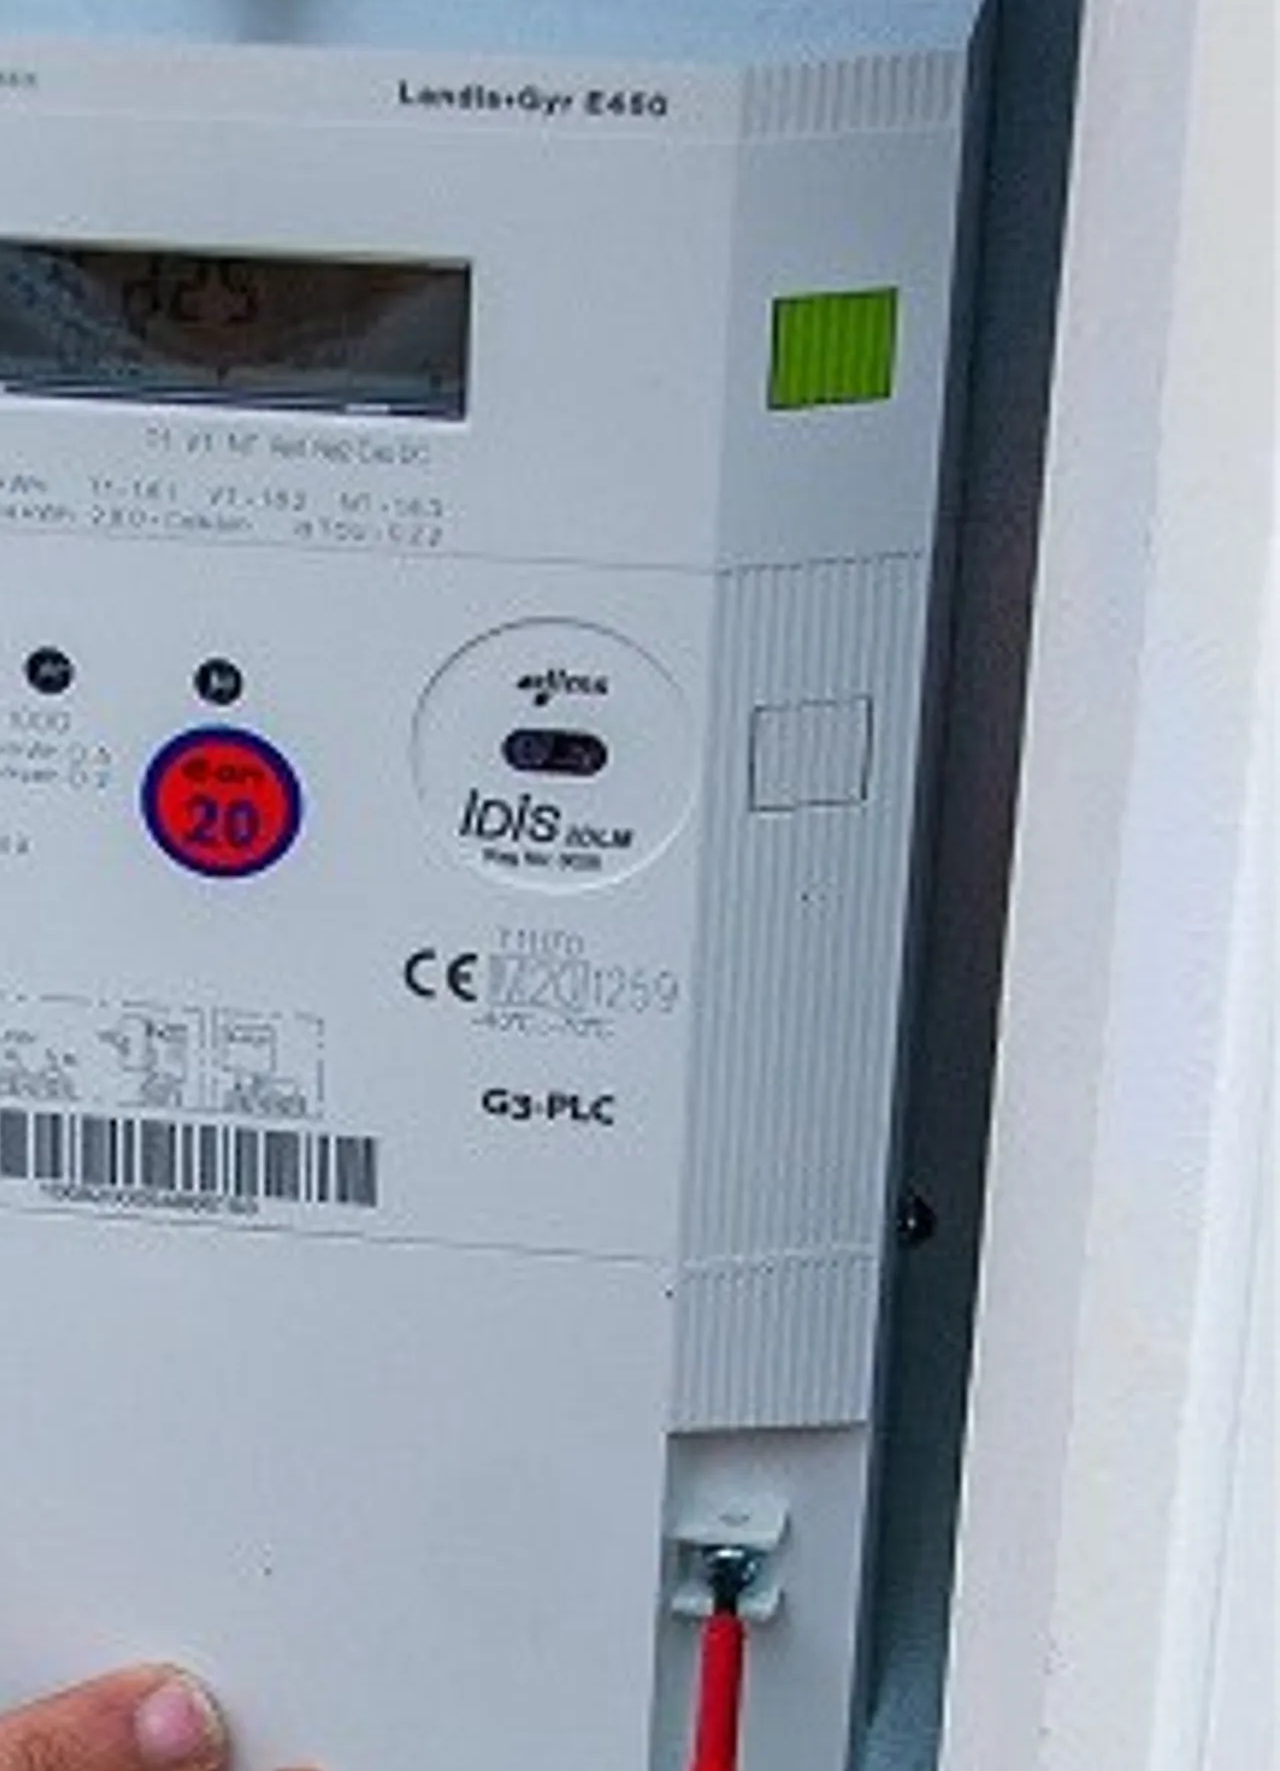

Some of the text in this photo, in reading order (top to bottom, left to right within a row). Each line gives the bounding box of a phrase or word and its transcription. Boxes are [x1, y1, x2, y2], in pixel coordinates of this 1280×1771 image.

[185, 792, 261, 849] 20
[404, 947, 478, 1003] CE
[481, 1087, 615, 1127] G3-PLC
